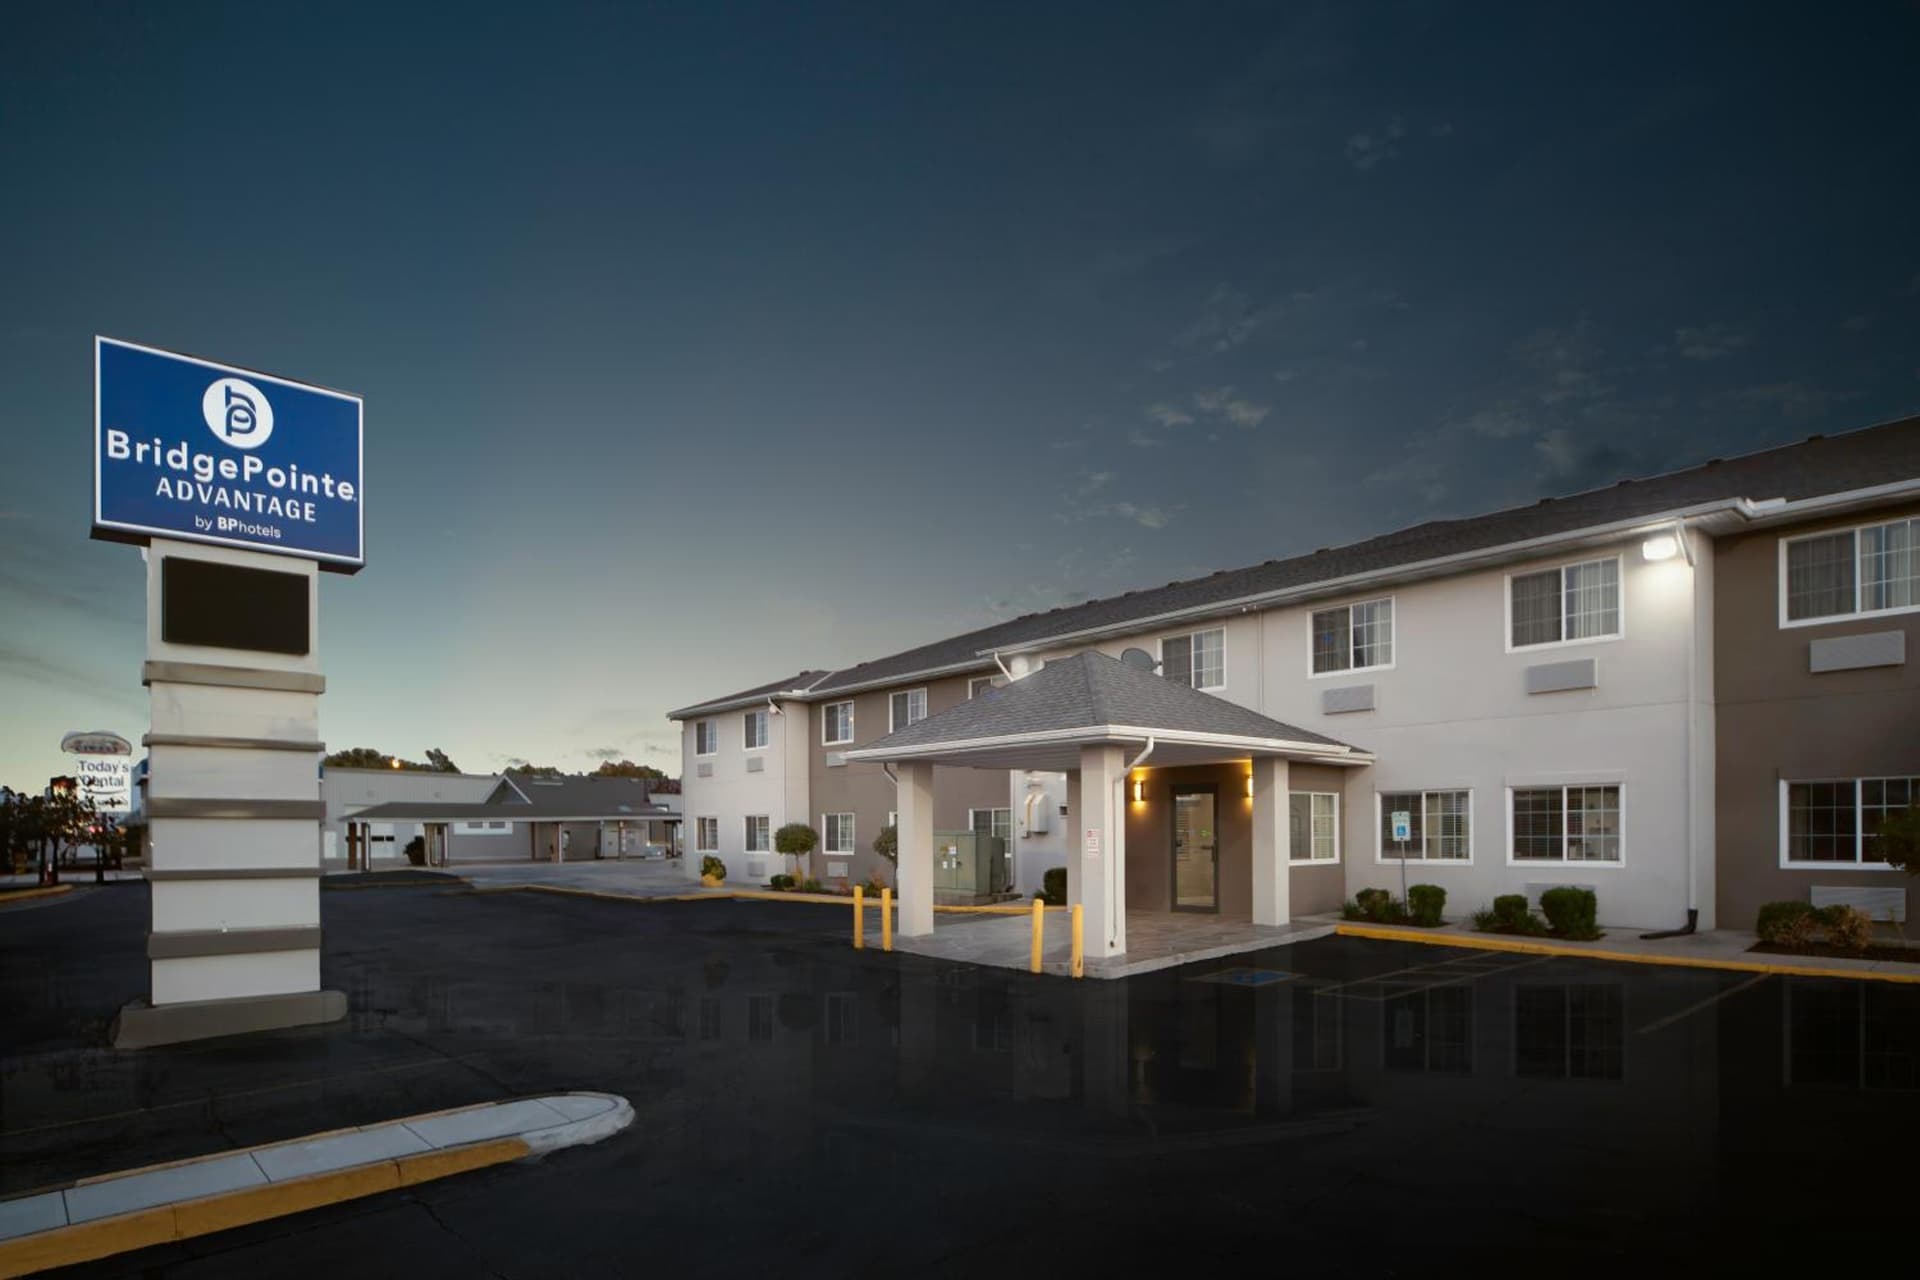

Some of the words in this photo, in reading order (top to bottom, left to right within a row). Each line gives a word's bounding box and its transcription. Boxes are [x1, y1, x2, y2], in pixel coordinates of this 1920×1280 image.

[107, 430, 354, 501] BridgePointe
[157, 478, 316, 521] ADVANTAGE
[196, 516, 212, 529] by
[218, 517, 281, 538] BPhotels
[79, 760, 128, 774] Today's
